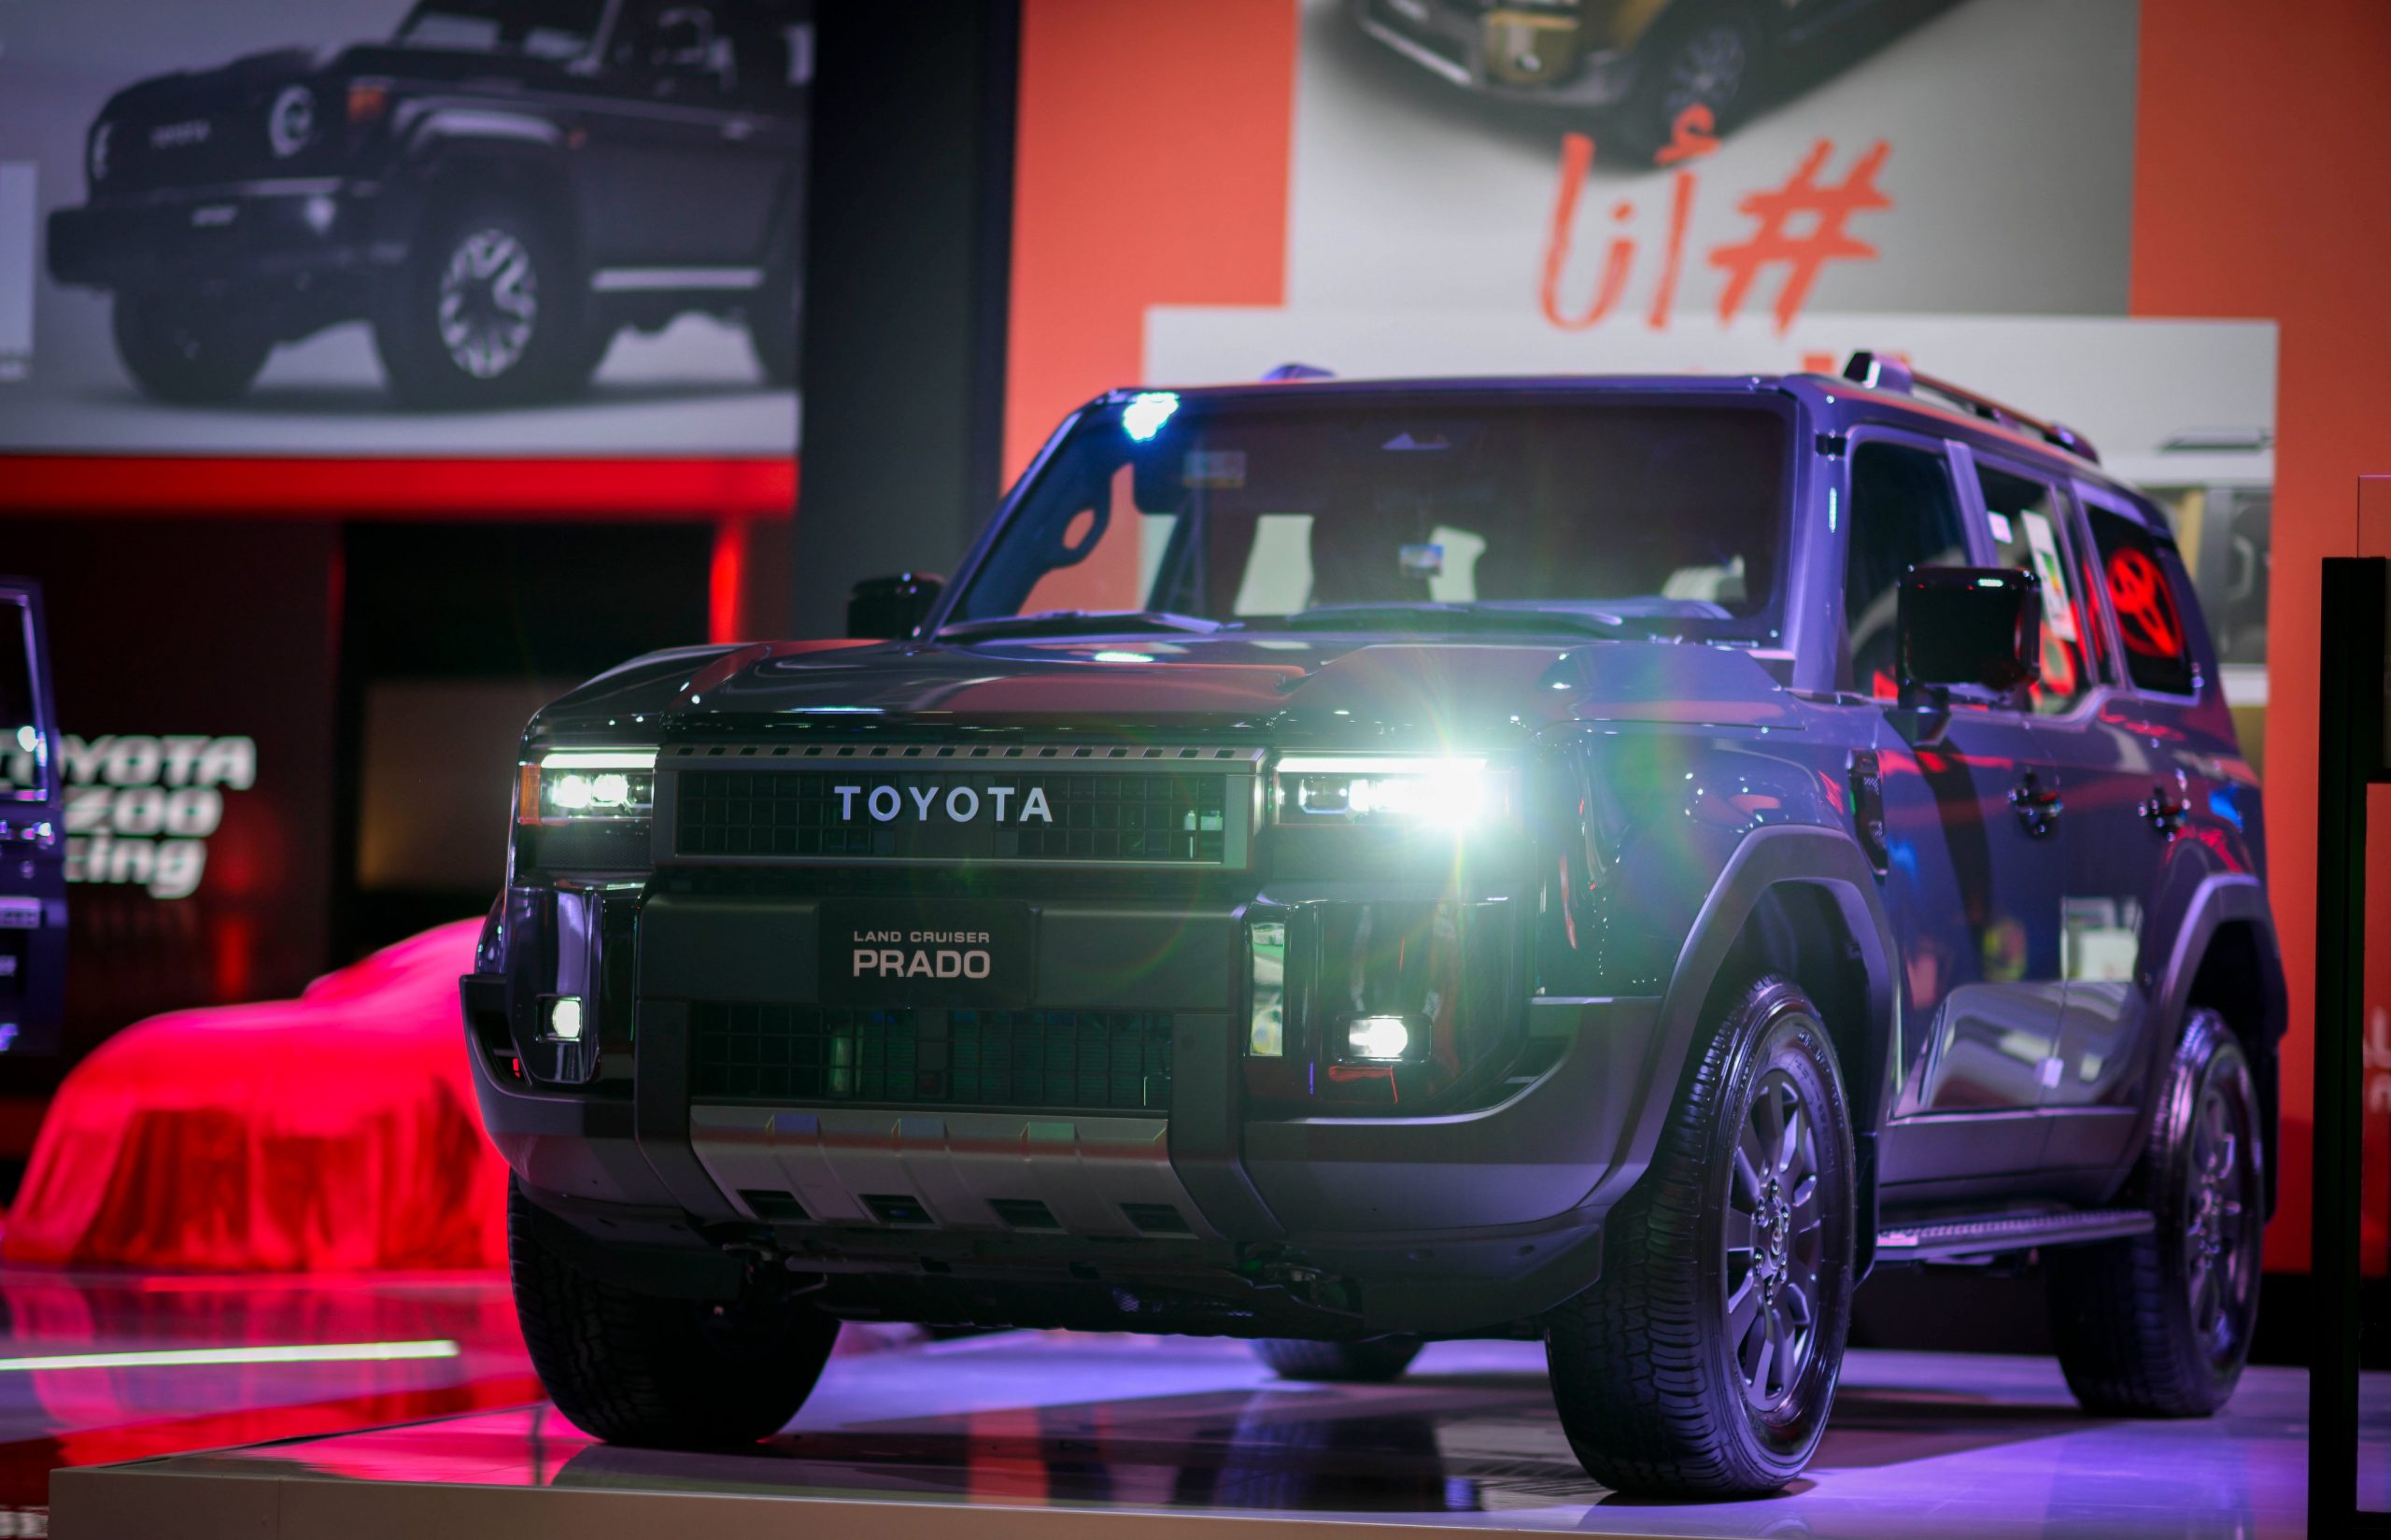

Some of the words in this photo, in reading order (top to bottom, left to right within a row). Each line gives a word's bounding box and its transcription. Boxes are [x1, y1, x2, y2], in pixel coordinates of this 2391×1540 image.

[0, 728, 258, 791] YOTA
[63, 784, 224, 838] ZOO
[833, 784, 1054, 823] TOYOTA
[854, 930, 902, 943] LAND
[910, 931, 991, 944] CRUISER
[853, 949, 992, 979] PRADO
